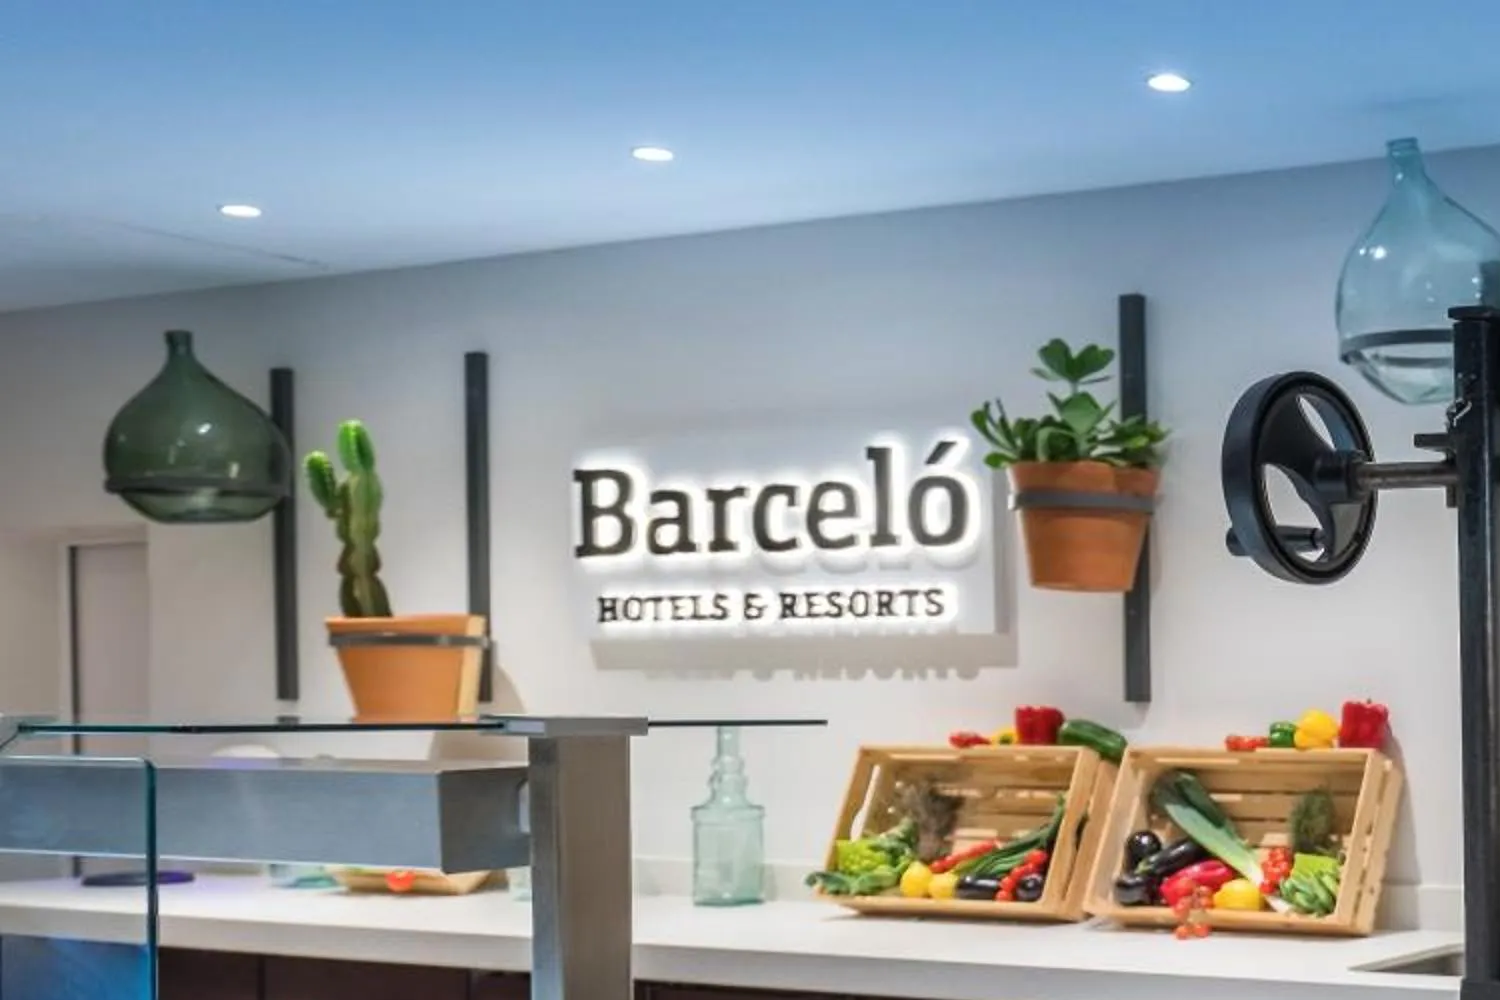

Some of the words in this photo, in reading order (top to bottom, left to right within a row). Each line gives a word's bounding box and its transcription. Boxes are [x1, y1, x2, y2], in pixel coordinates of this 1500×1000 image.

[572, 440, 970, 558] Barceló
[597, 593, 729, 623] HOTELS
[743, 593, 767, 620] &
[779, 588, 945, 620] RESORTS
